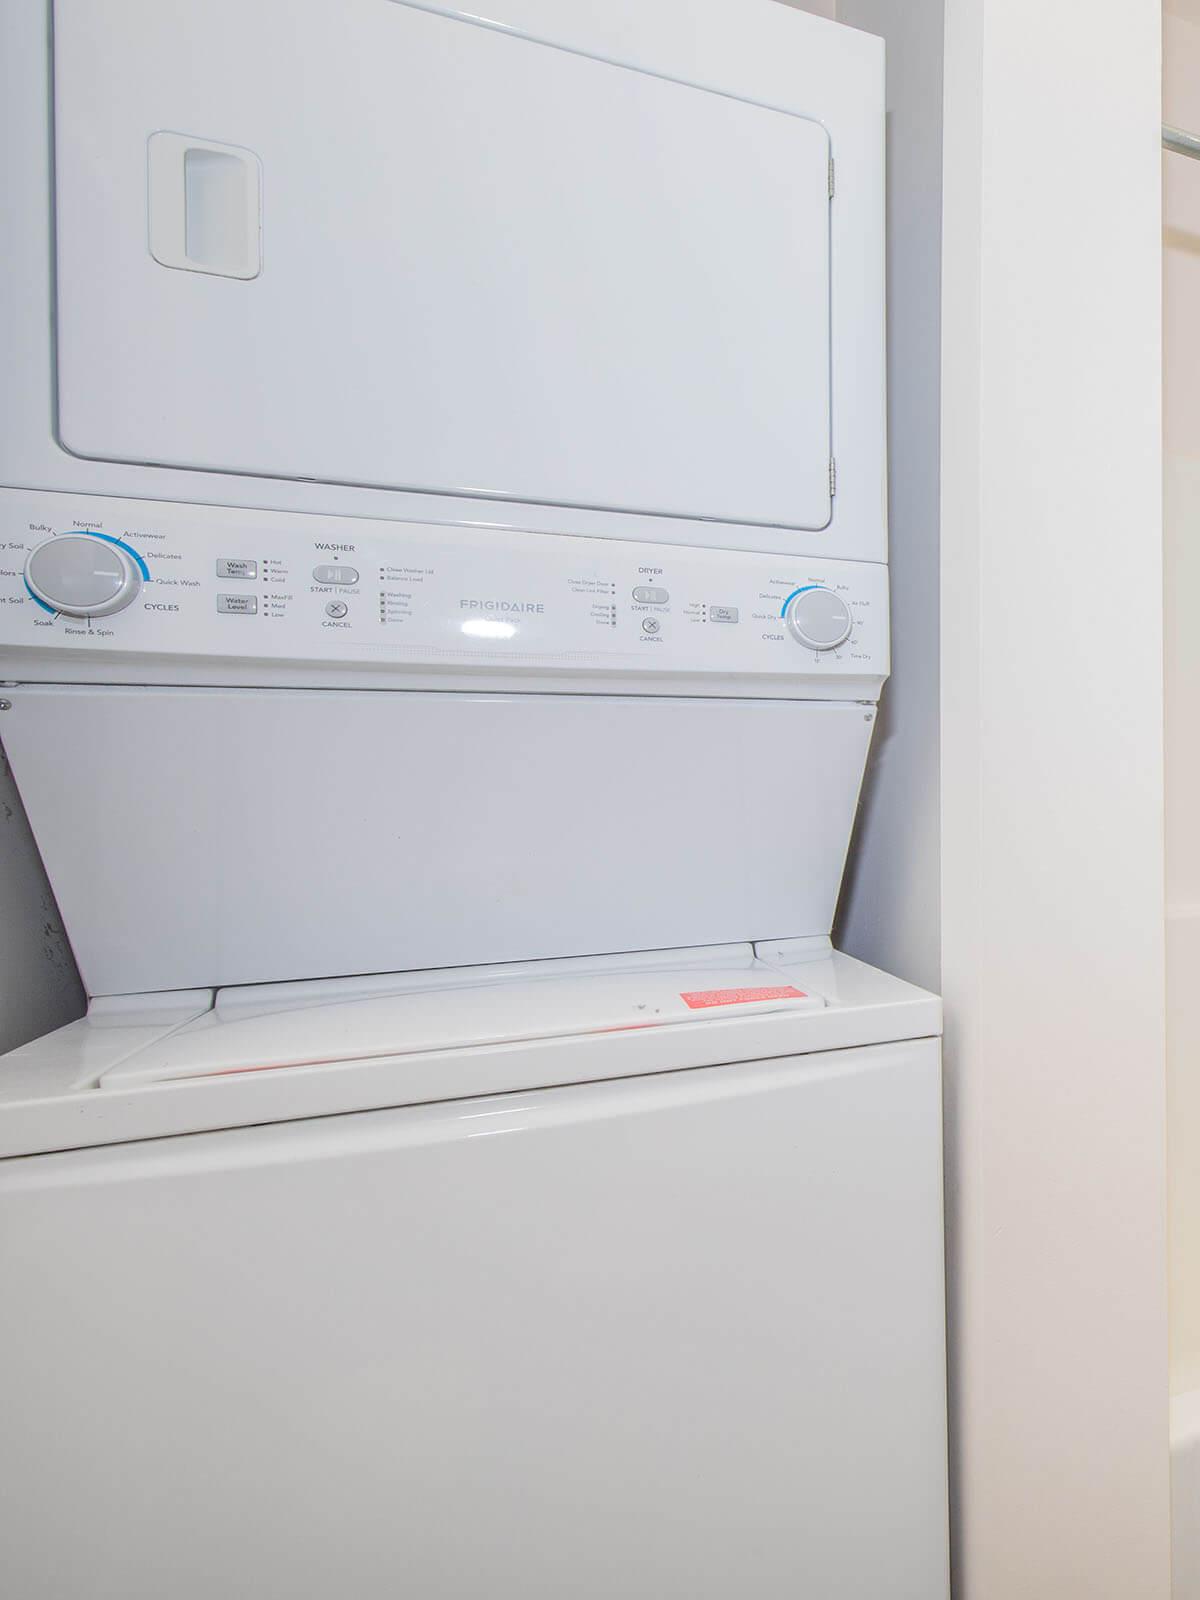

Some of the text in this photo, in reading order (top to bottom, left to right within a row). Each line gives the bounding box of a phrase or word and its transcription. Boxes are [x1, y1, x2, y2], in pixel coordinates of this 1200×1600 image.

[29, 523, 52, 533] Bulky
[73, 520, 103, 529] Normal
[123, 530, 166, 541] Activewear
[8, 542, 24, 550] Soil
[314, 542, 356, 552] WASHER
[147, 551, 182, 560] Delicates
[226, 561, 248, 569] Wash
[638, 567, 663, 575] DRYER
[155, 578, 201, 587] Quick Wash
[144, 602, 180, 612] CYCLES
[459, 599, 545, 614] FRIGIDAIRE
[33, 619, 54, 627] Soak
[321, 620, 353, 629] CANCEL
[64, 627, 115, 638] Rinse & Spin
[761, 633, 785, 641] CYCLES
[639, 635, 664, 643] CANCEL
